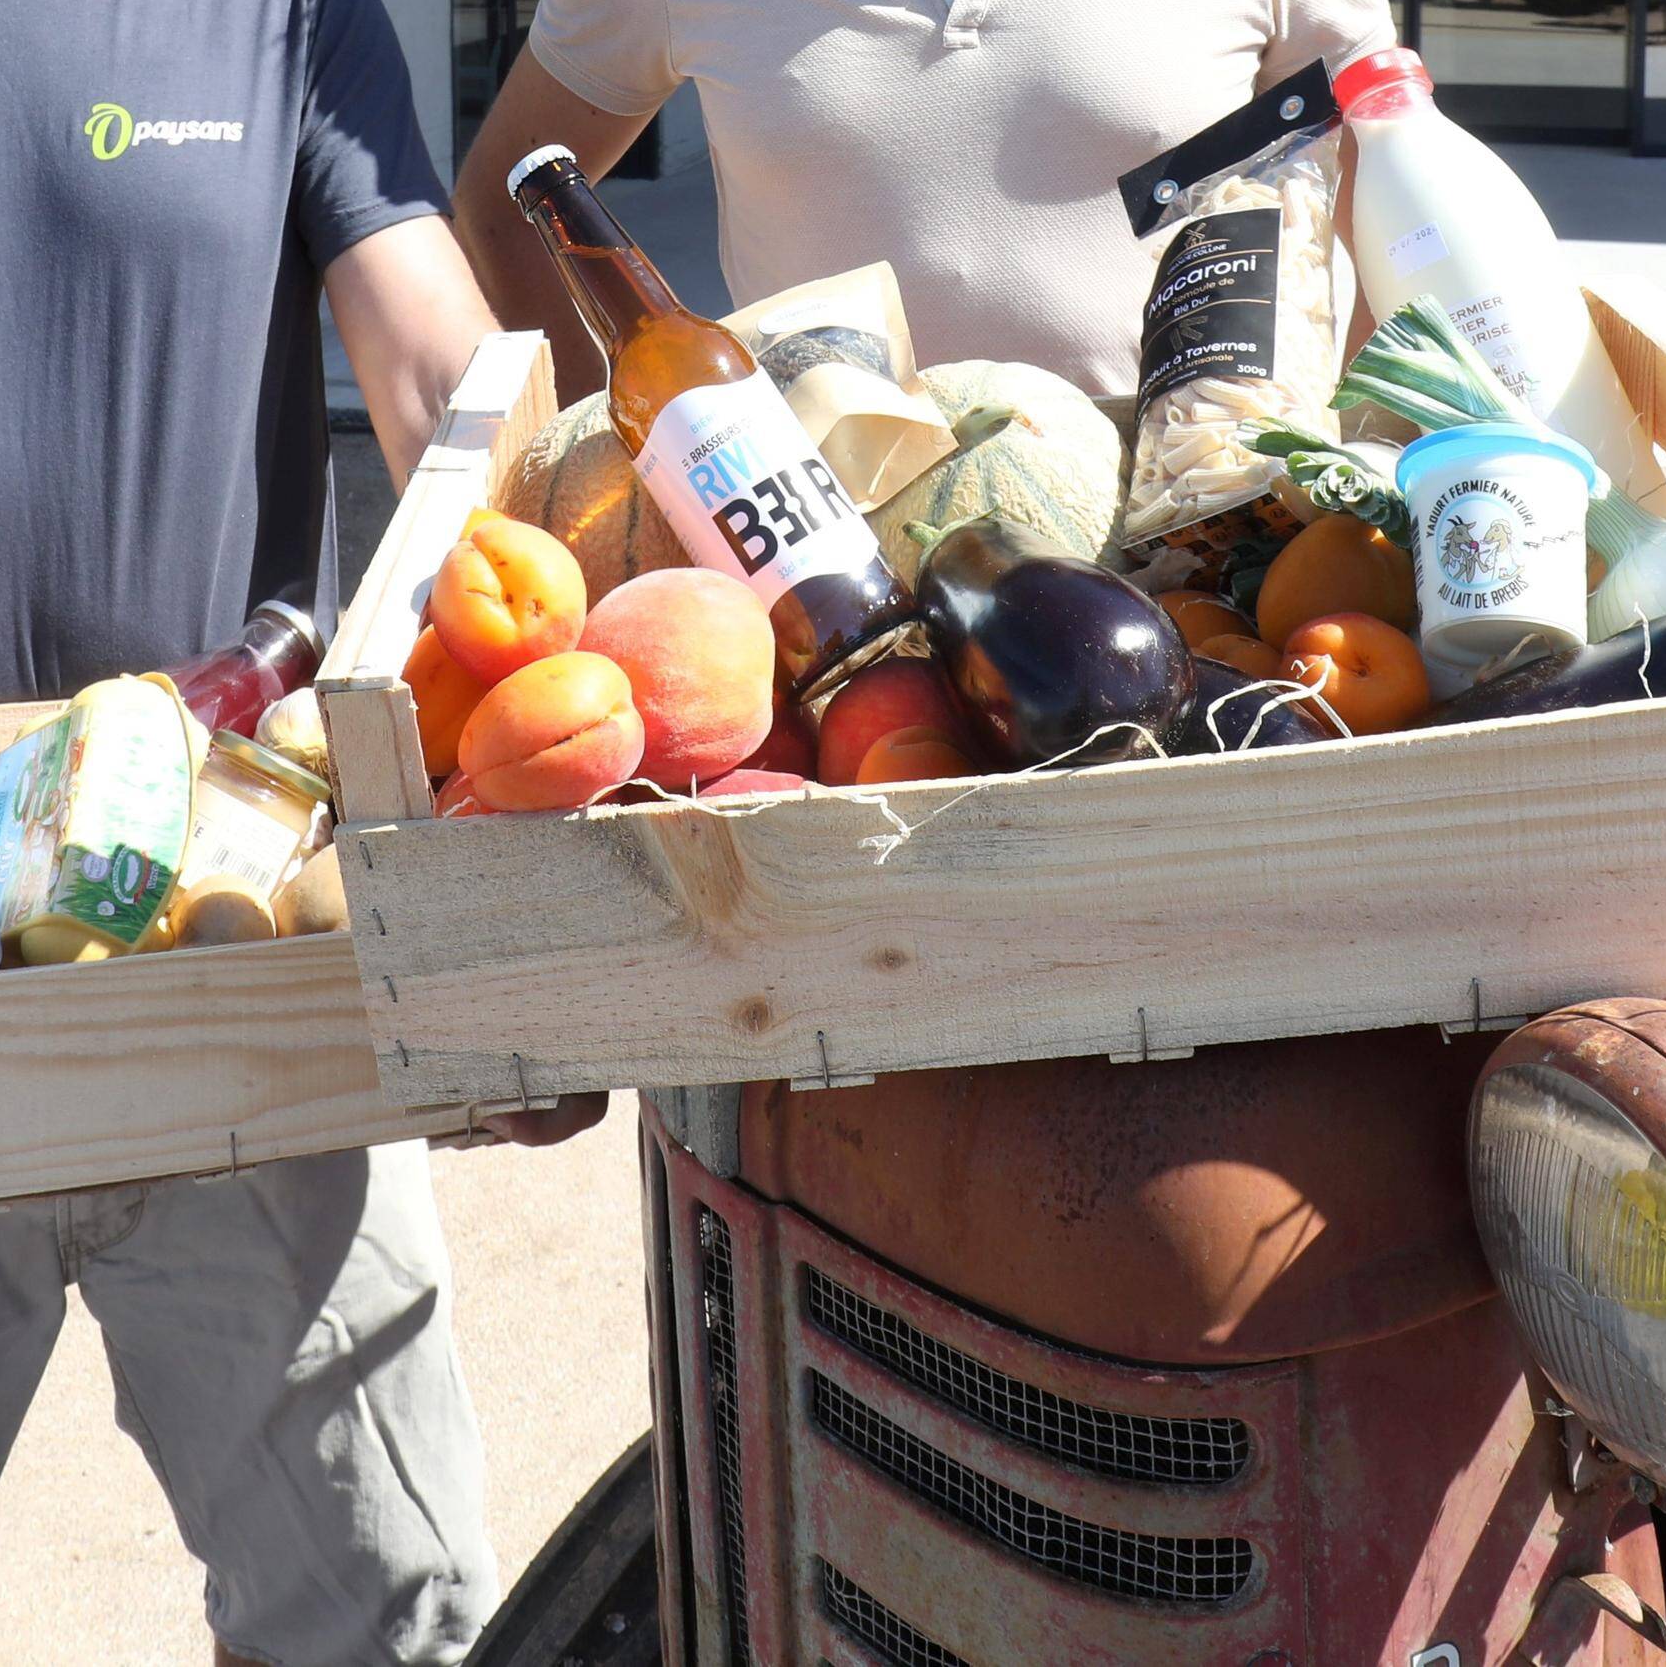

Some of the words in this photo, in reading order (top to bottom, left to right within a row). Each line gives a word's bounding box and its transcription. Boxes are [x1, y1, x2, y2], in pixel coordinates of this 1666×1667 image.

[132, 119, 244, 147] paysans
[1148, 255, 1257, 319] Macaroni
[1218, 277, 1235, 287] de
[1191, 294, 1210, 309] Dur
[1448, 295, 1505, 324] ERMIER
[1185, 341, 1257, 359] Tavernes
[1237, 364, 1267, 377] 300g
[689, 425, 742, 465] BRASSEURS
[1426, 492, 1450, 539] YAOURT
[1448, 479, 1499, 500] FERMIER
[1500, 488, 1536, 527] NATURE
[1437, 582, 1451, 602] AU
[1450, 591, 1472, 610] LAIT
[1474, 593, 1489, 610] DE
[1492, 575, 1530, 607] BREBIS
